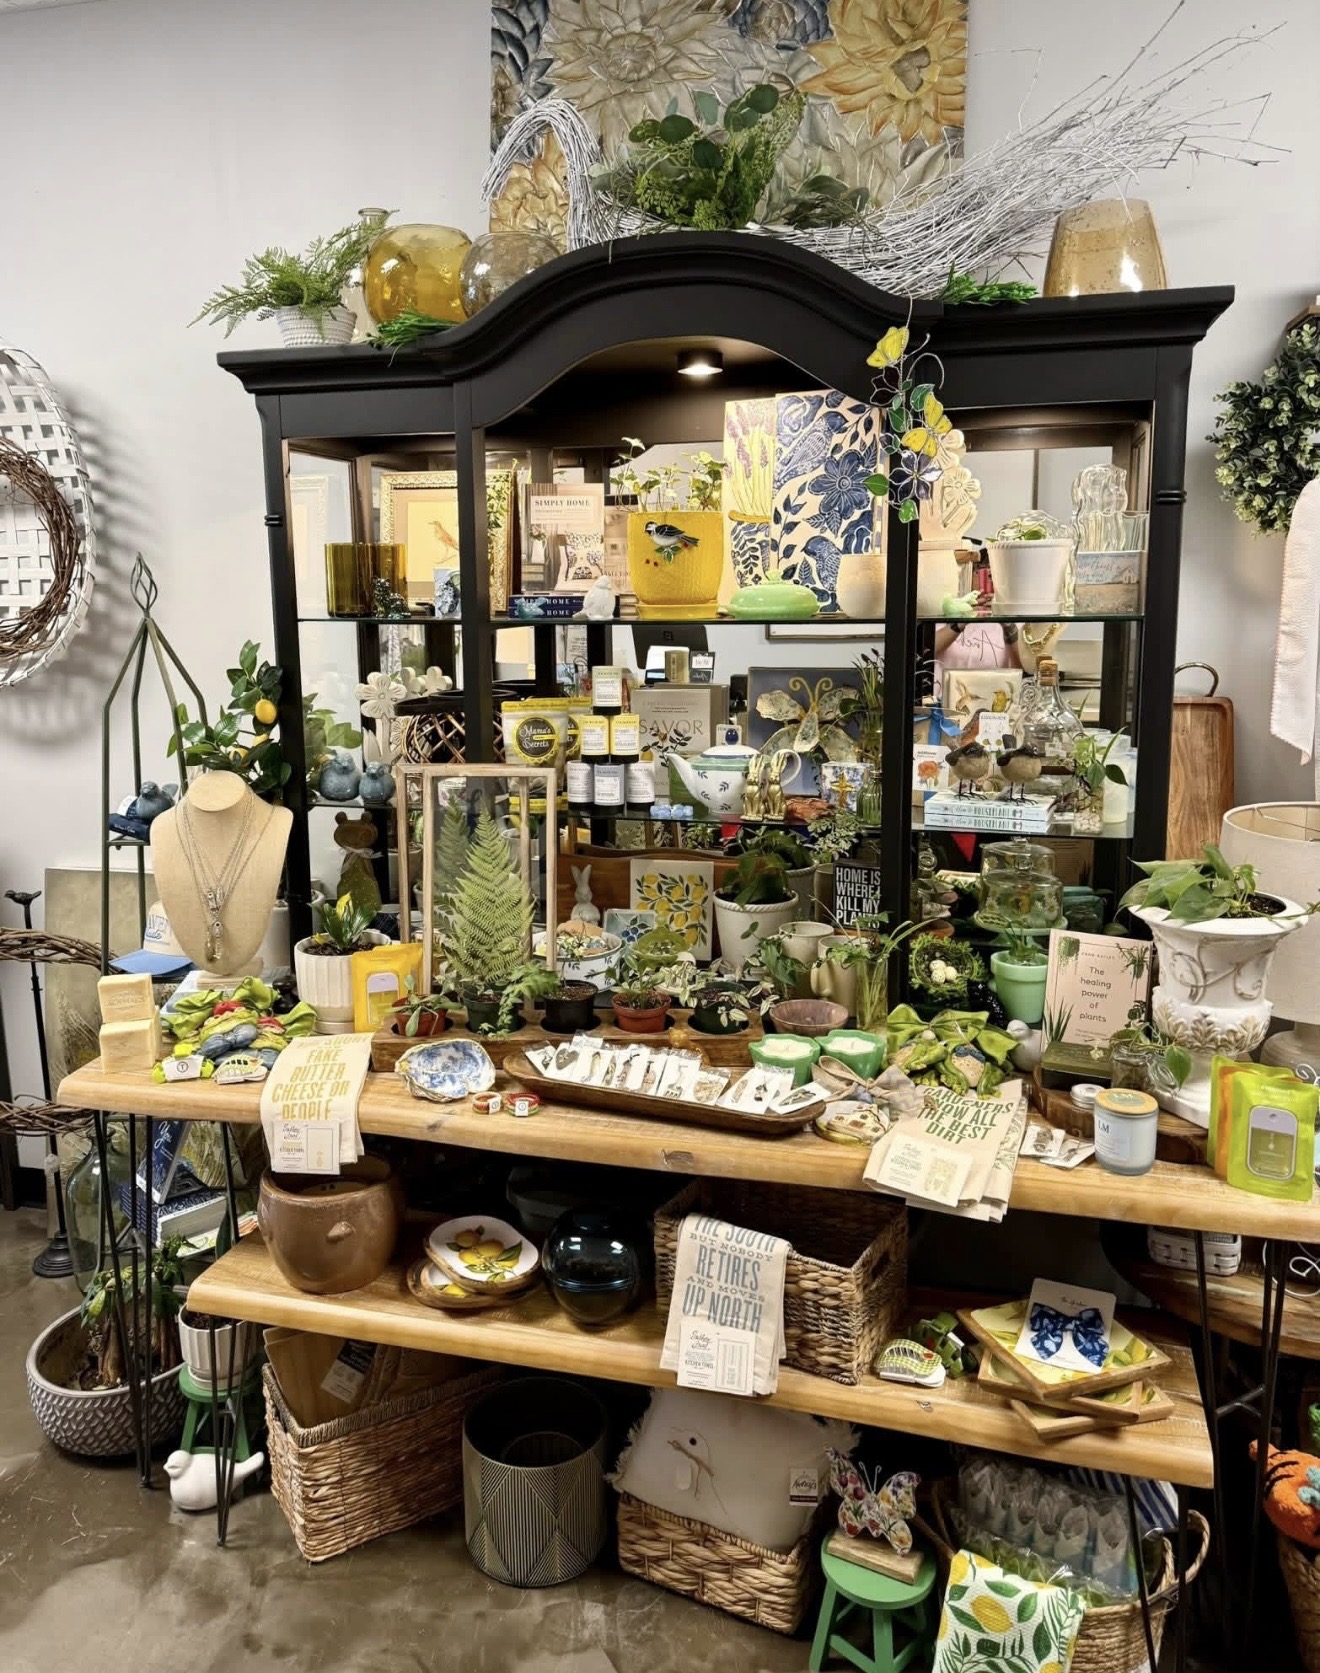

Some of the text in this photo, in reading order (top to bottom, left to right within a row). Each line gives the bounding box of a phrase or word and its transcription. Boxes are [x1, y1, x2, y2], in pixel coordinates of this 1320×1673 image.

[535, 499, 591, 507] SIMPLY HOME
[520, 725, 551, 737] Mama's
[639, 719, 703, 735] SAVOR
[522, 739, 550, 749] Secrets
[836, 867, 881, 886] HOME IS
[836, 881, 875, 898] WHERE
[836, 895, 880, 914] KILL MY
[1089, 966, 1105, 976] The
[1080, 977, 1112, 989] healing
[1081, 989, 1109, 999] power
[1089, 1001, 1099, 1009] of
[1080, 1011, 1107, 1022] plants
[307, 1048, 343, 1063] FAKE
[290, 1063, 347, 1082] BUTTER
[271, 1080, 351, 1103] CHEESE OR
[917, 1107, 992, 1140] THE BEST
[969, 1108, 997, 1127] ALL
[925, 1121, 967, 1144] DIRT
[689, 1233, 773, 1263] BUT NOBODY
[695, 1245, 761, 1291] RETIRES
[686, 1275, 766, 1303] AND MOVES
[682, 1284, 763, 1333] UP NORTH
